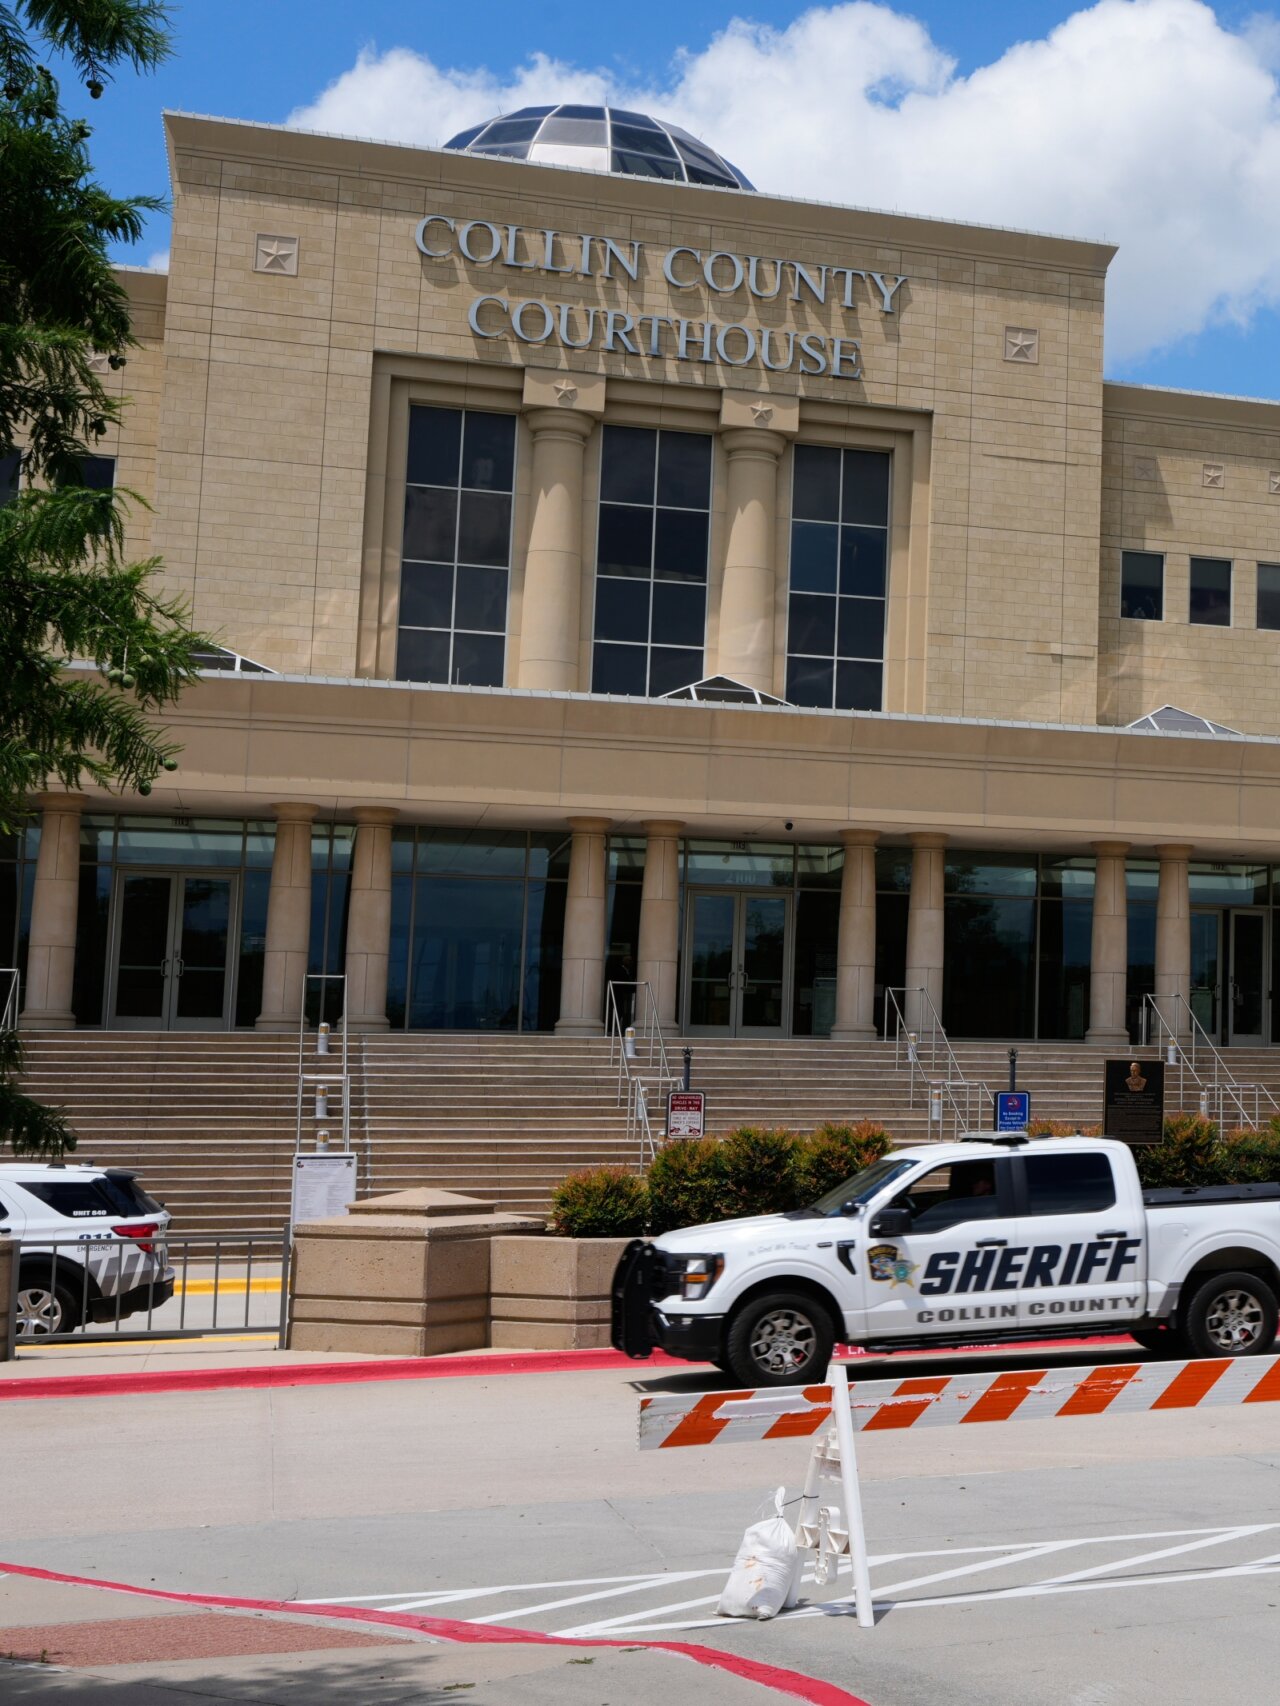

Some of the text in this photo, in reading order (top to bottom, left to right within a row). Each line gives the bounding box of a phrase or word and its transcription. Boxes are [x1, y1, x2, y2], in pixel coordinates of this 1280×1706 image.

[414, 213, 909, 314] COLLIN COUNTY
[467, 294, 863, 380] COURTHOUSE
[77, 1244, 113, 1252] EMRGENCY
[919, 1238, 1142, 1296] SHERIFF
[916, 1295, 1141, 1324] COLLIN COUNTY
